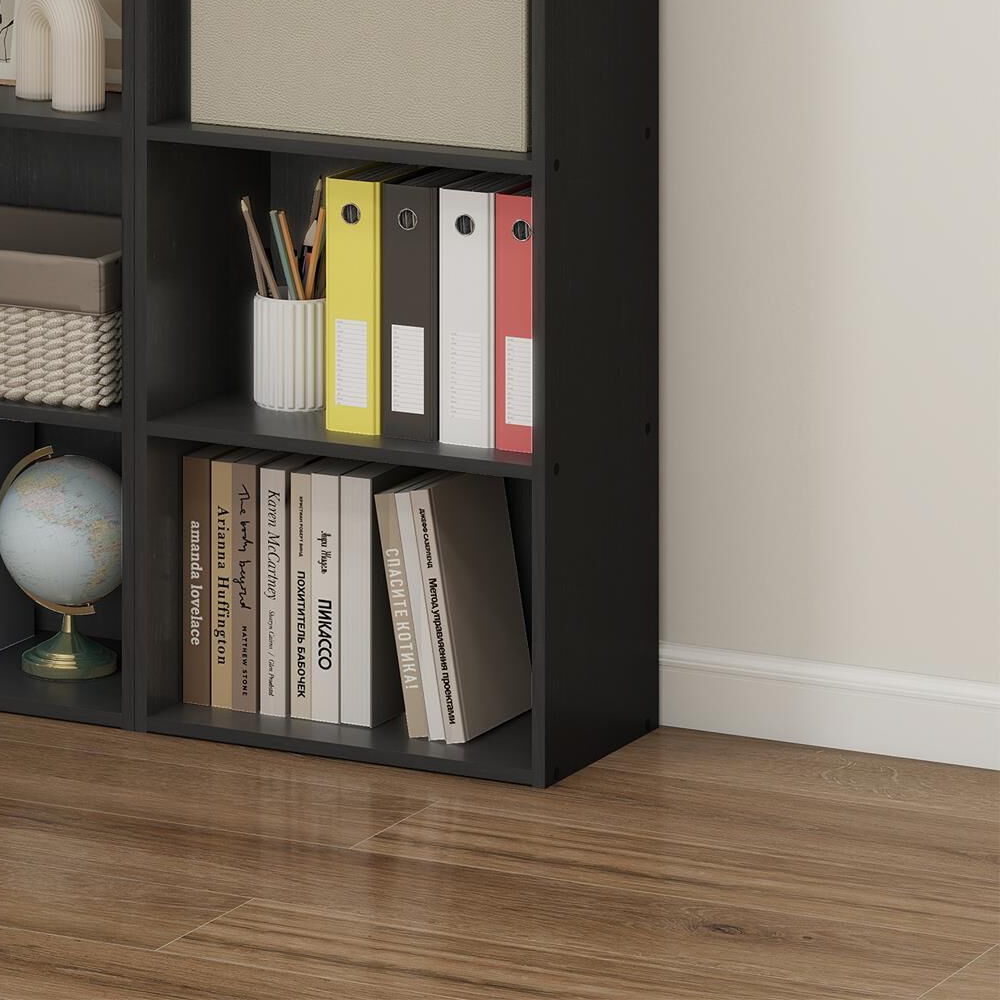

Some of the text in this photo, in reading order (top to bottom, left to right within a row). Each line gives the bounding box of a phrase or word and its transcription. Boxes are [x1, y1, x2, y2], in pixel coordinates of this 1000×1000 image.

[190, 520, 204, 647] amanda lovelace
[232, 484, 254, 610] The body beyond
[263, 489, 281, 601] Karen McCartney
[419, 507, 428, 533] ДЖЕФФ
[213, 505, 230, 665] Arianna Huffington
[296, 570, 306, 699] ПОХИТИТЕЛЬ БАБОЧЕК
[317, 599, 333, 671] ПИКАССО
[385, 548, 419, 690] СПАСИТЕ КОТИКА!
[428, 577, 439, 610] Метод
[441, 672, 456, 725] проектами
